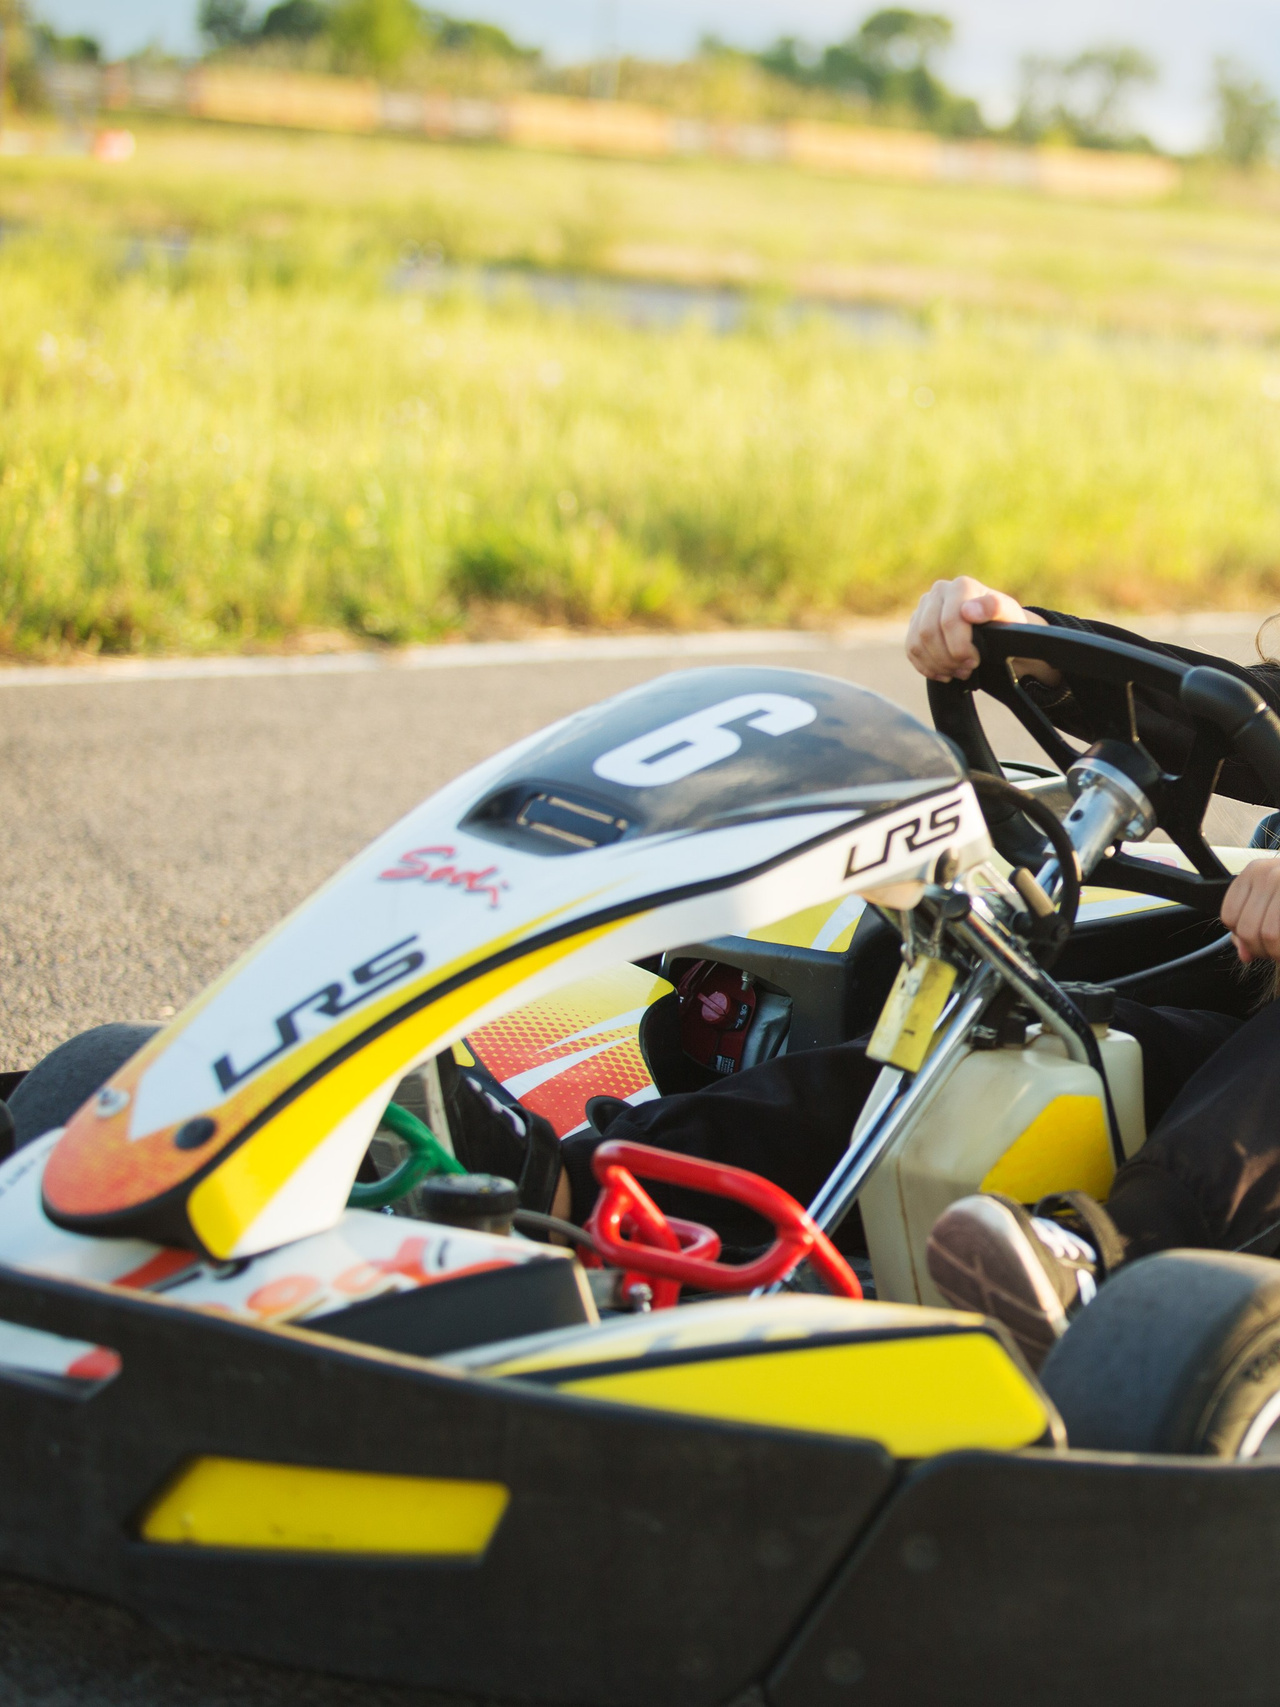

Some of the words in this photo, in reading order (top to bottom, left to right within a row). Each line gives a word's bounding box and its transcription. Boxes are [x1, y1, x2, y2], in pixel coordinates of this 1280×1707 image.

[592, 693, 817, 787] 6
[844, 798, 962, 880] LRS
[213, 934, 425, 1093] LRS
